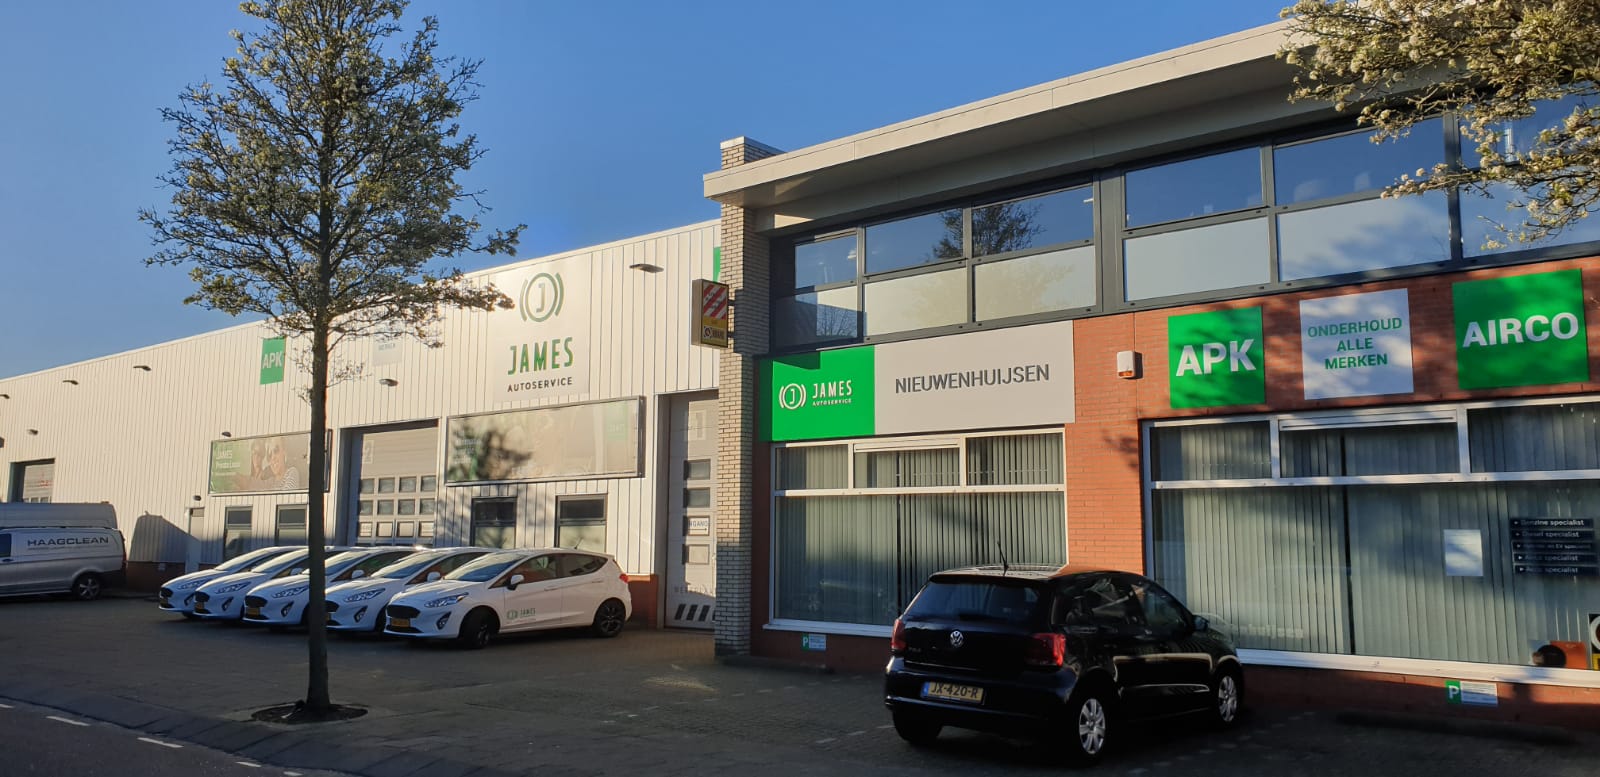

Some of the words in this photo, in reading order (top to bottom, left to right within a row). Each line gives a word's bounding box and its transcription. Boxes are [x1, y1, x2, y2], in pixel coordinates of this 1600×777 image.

[1307, 317, 1403, 339] ONDERHOUD
[1462, 311, 1579, 348] AIRCO
[1336, 337, 1374, 352] ALLE
[262, 351, 283, 369] APK
[507, 336, 574, 376] JAMES
[1175, 338, 1257, 377] APK
[1323, 353, 1388, 370] MERKEN
[507, 376, 573, 393] AUTOSERVICE
[895, 363, 1050, 394] NIEUWENHUIJSEN
[812, 379, 852, 399] JAMES
[812, 398, 852, 407] AUTOSERVICE
[27, 536, 109, 547] HAAGCLEAN
[930, 682, 979, 699] JX-420-R
[1449, 685, 1460, 700] P
